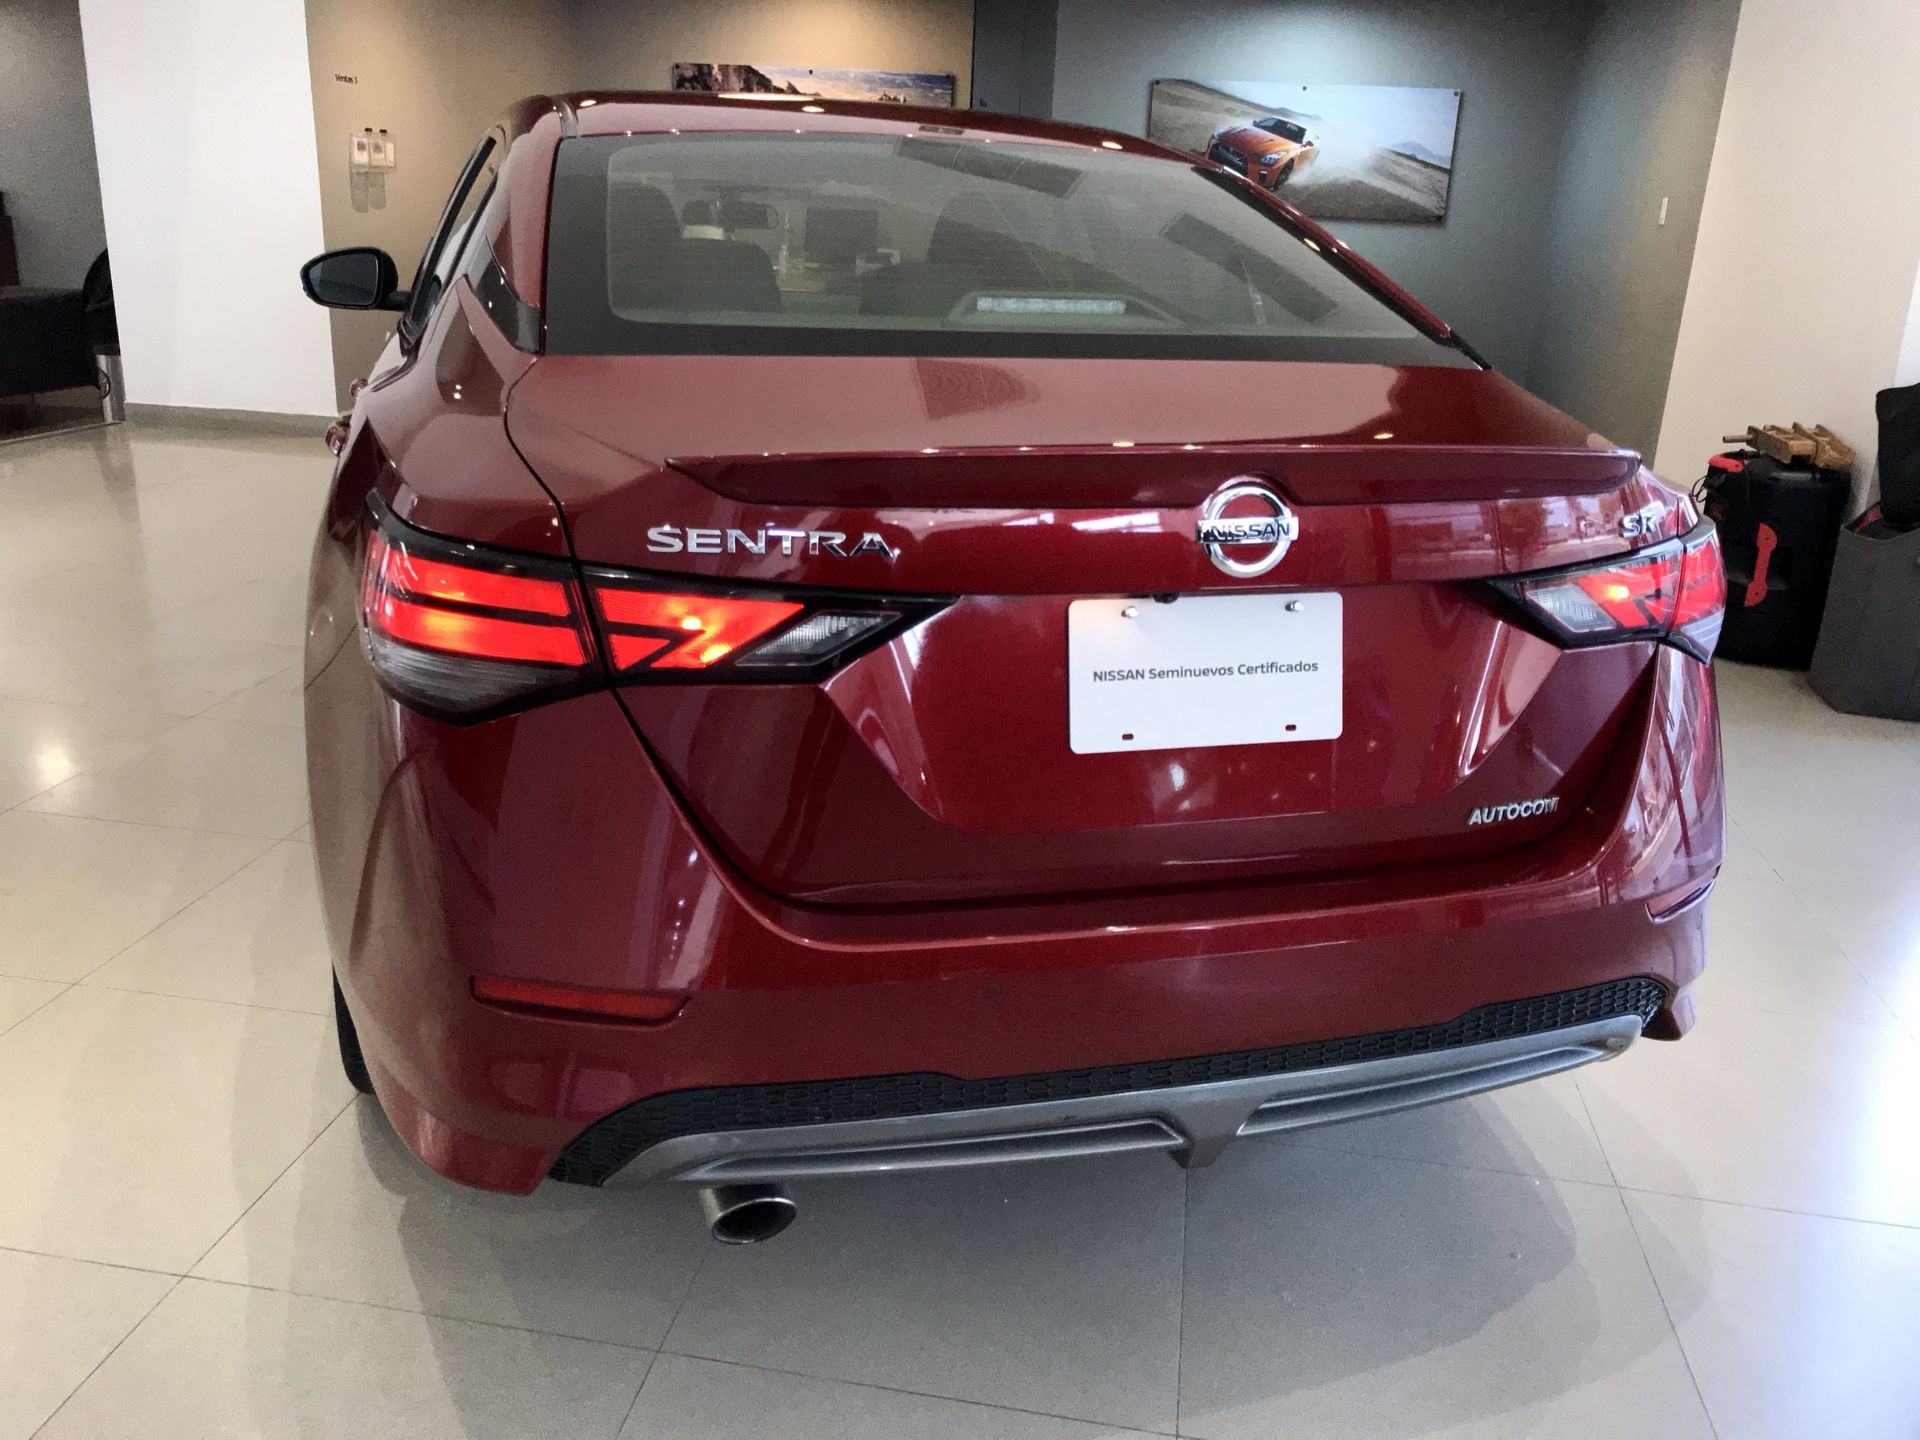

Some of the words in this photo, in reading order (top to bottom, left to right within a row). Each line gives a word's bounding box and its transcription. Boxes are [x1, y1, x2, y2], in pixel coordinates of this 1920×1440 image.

[1210, 523, 1290, 540] NISSAN
[1622, 511, 1657, 538] SR
[647, 527, 895, 558] SENTRA
[1093, 669, 1145, 682] NISSAN
[1148, 665, 1234, 680] Seminuevos
[1237, 661, 1319, 675] Certificados
